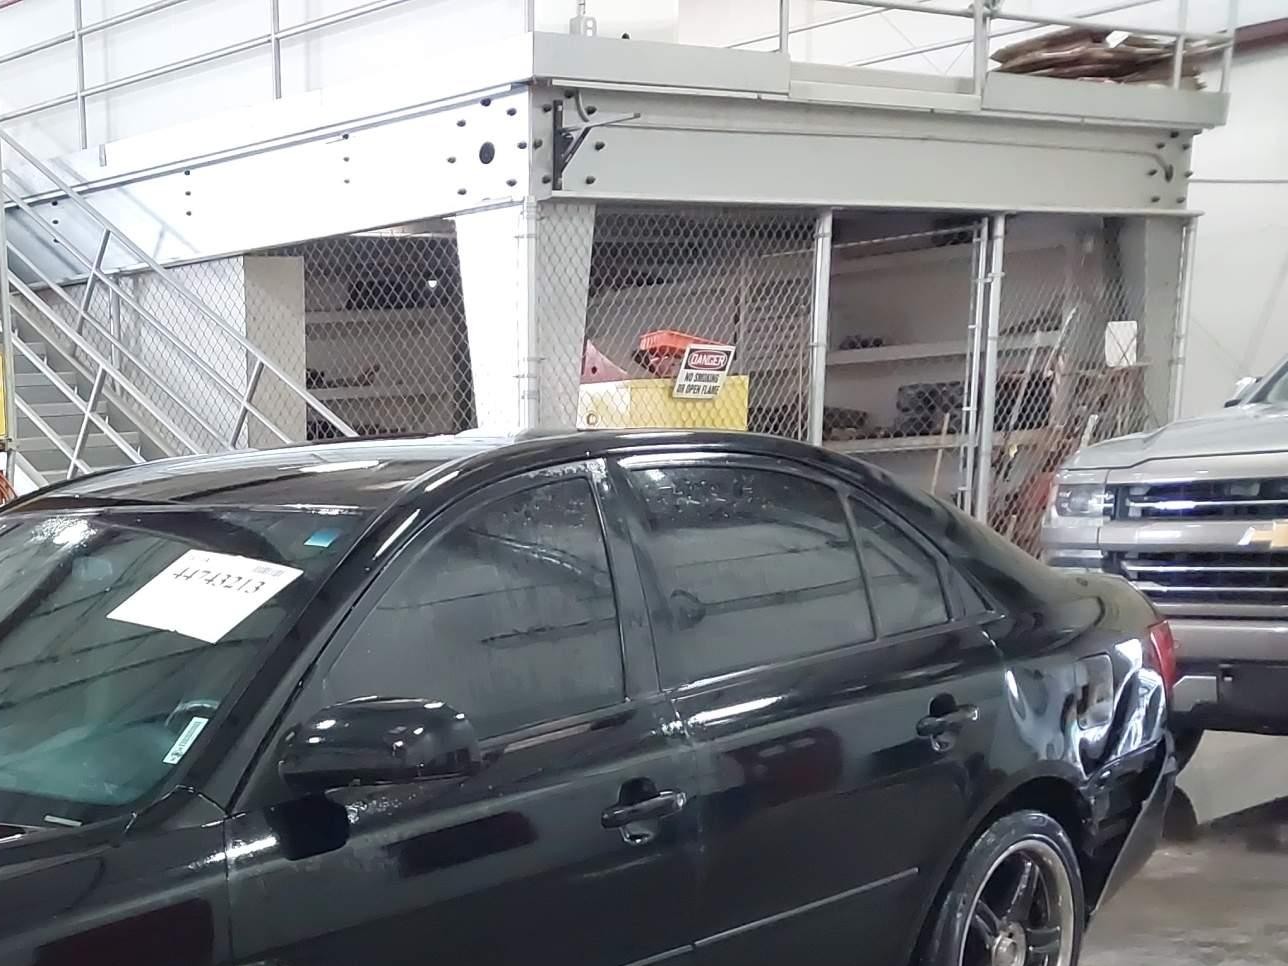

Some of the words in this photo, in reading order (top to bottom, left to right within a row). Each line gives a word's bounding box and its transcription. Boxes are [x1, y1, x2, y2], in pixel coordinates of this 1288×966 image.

[691, 353, 725, 367] DANGER
[684, 372, 694, 382] NO
[694, 373, 720, 383] SMOKING
[686, 383, 701, 394] OPEN
[701, 384, 720, 395] FLAME
[173, 567, 266, 594] 44743213
